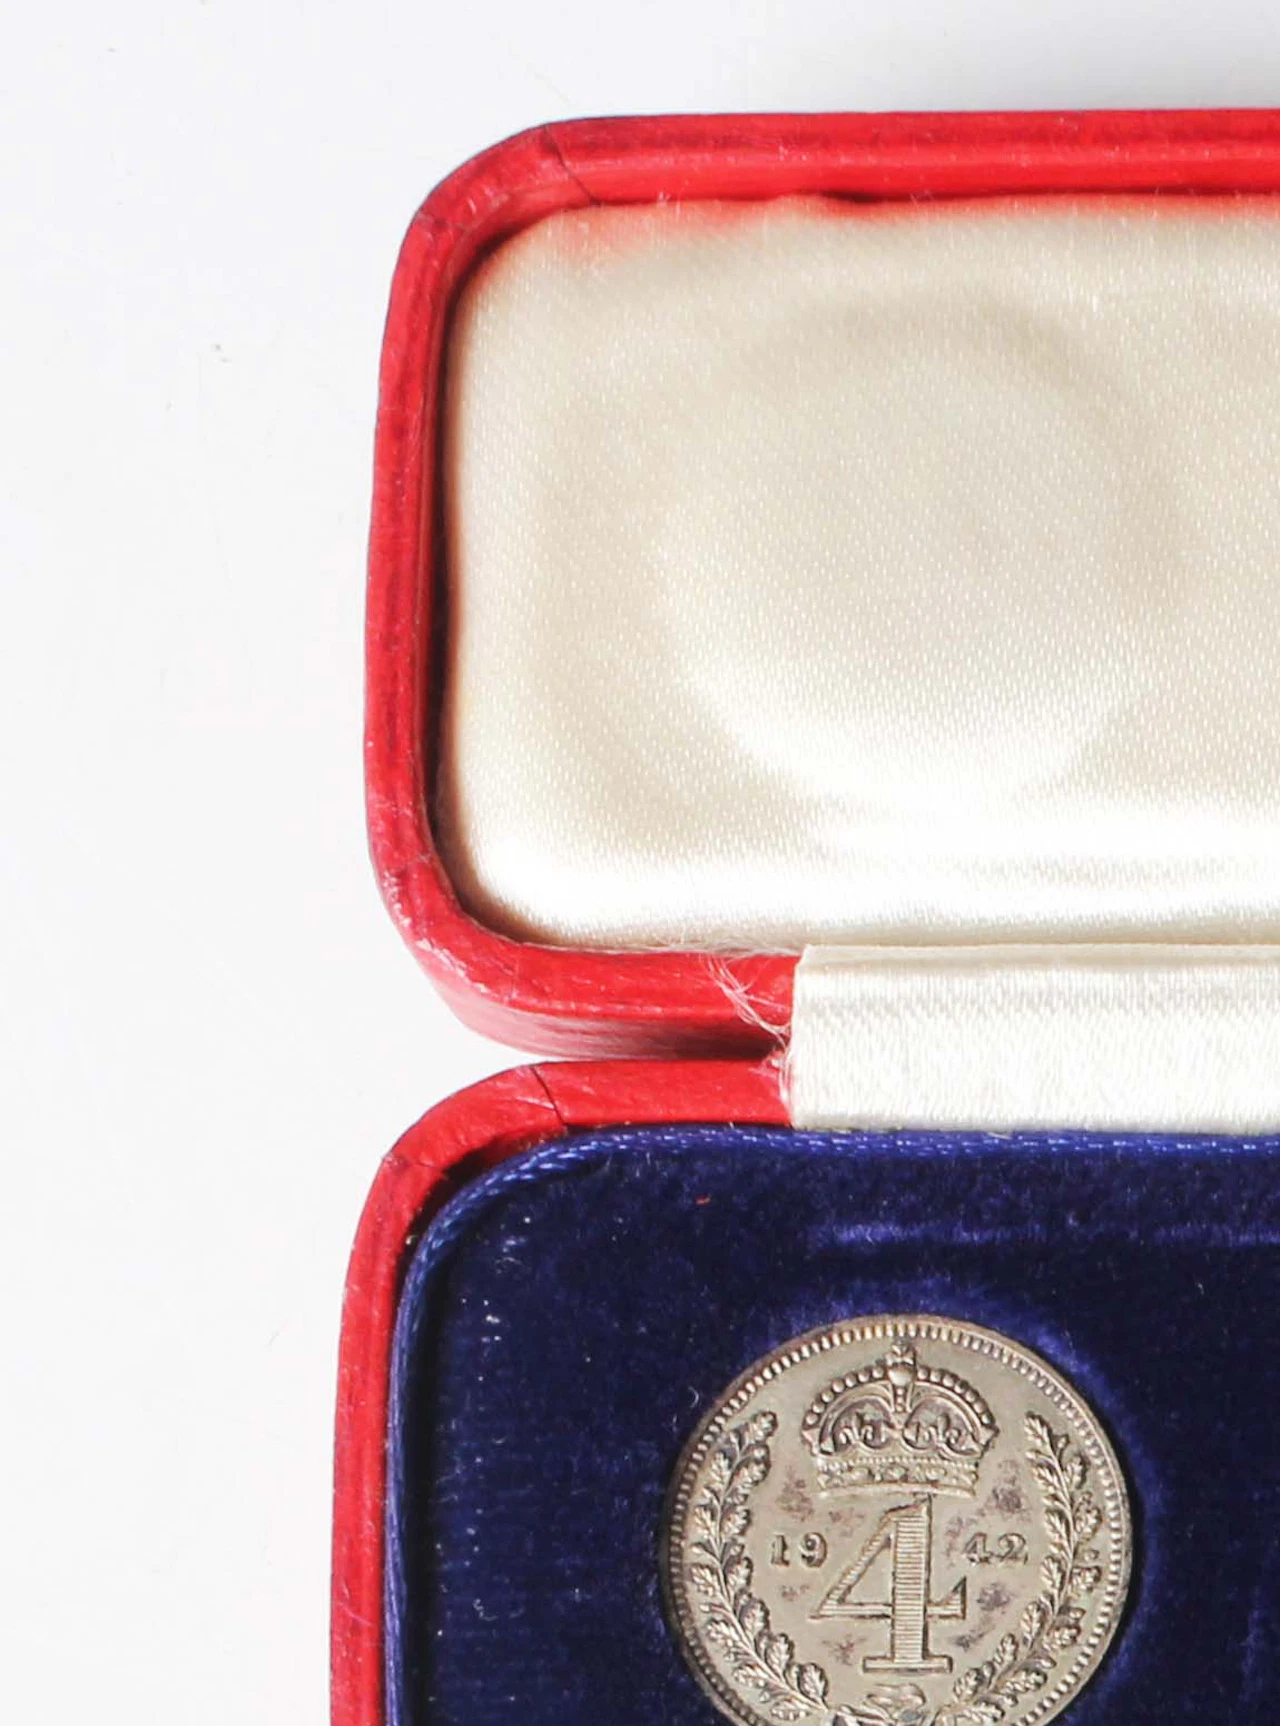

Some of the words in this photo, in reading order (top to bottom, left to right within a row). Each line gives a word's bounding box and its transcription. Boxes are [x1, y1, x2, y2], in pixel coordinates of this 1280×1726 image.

[770, 1532, 828, 1569] 19
[963, 1532, 1029, 1567] 42
[808, 1496, 967, 1674] 4
